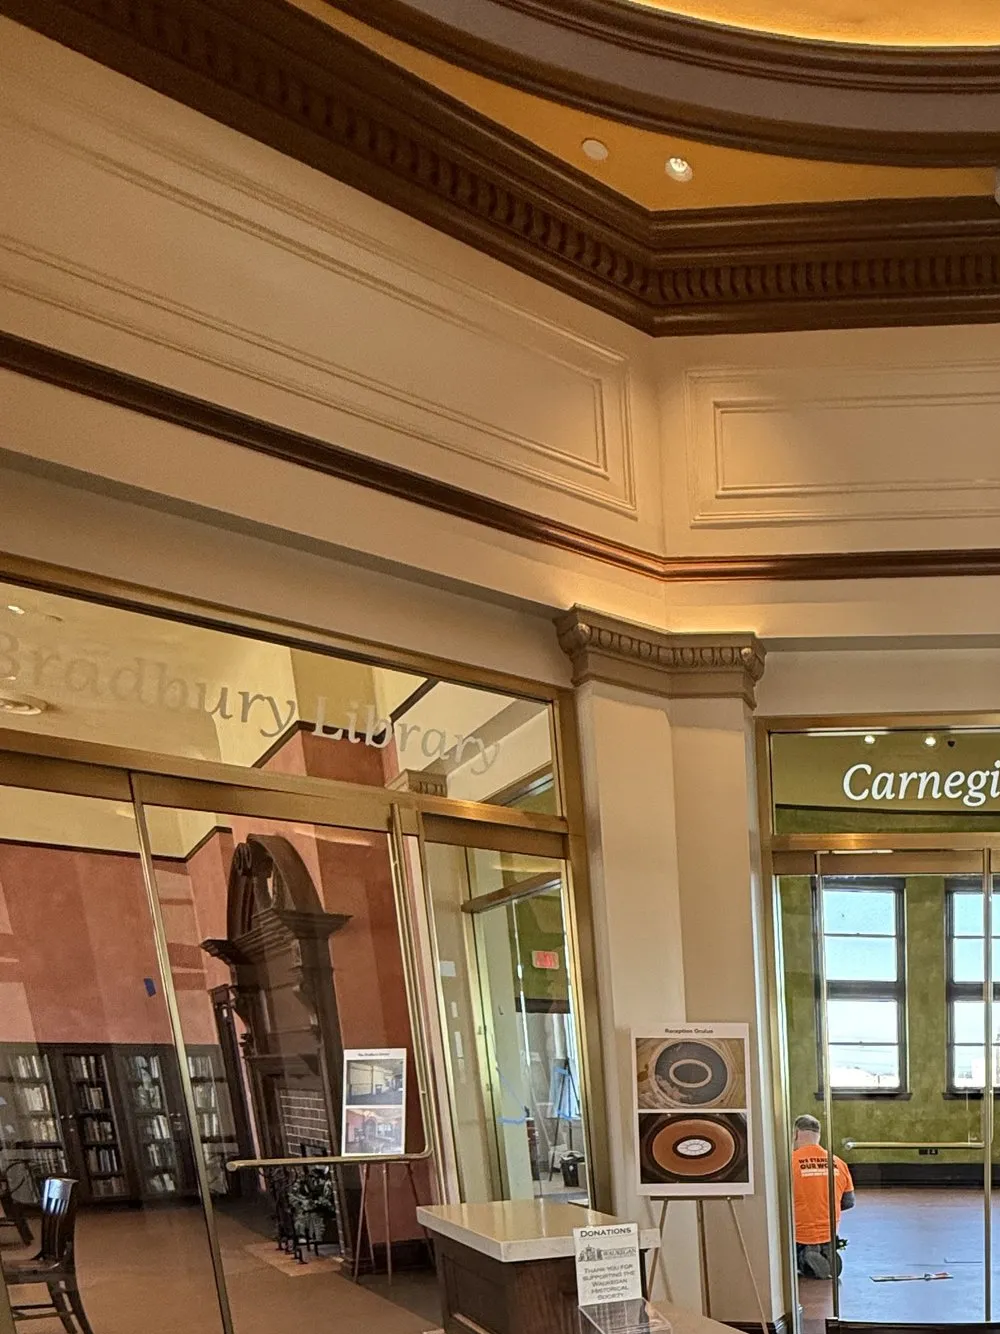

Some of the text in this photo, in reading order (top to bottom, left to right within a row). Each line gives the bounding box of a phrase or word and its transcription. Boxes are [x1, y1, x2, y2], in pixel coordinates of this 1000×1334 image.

[312, 696, 500, 775] Library
[817, 1162, 839, 1170] WOK
[580, 1227, 632, 1238] DONATIONS
